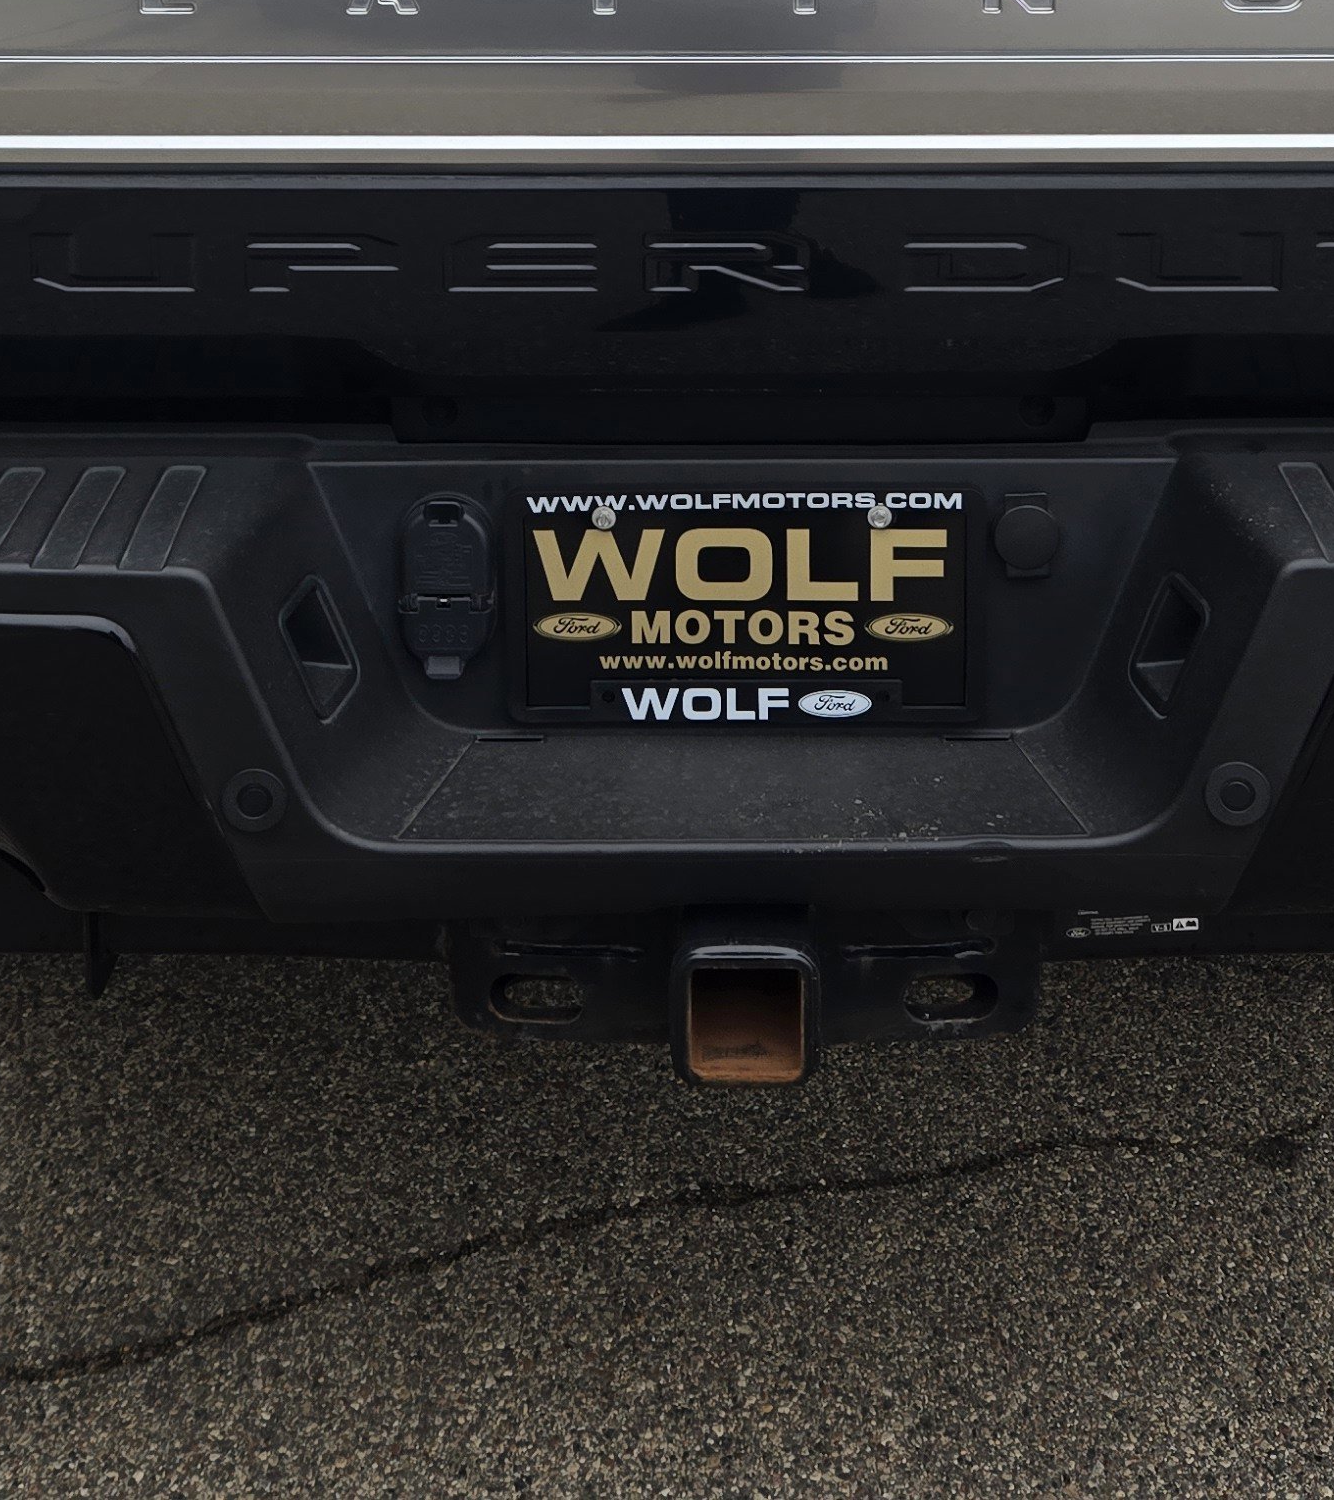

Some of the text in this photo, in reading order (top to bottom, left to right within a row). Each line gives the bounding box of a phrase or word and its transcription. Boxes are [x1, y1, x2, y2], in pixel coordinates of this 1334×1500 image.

[532, 528, 948, 601] WOLF
[553, 617, 600, 636] Ford
[631, 610, 855, 645] MOTORS
[884, 617, 932, 636] Ford
[599, 651, 888, 672] www.wolfmotors.com
[621, 688, 789, 721] WOLF
